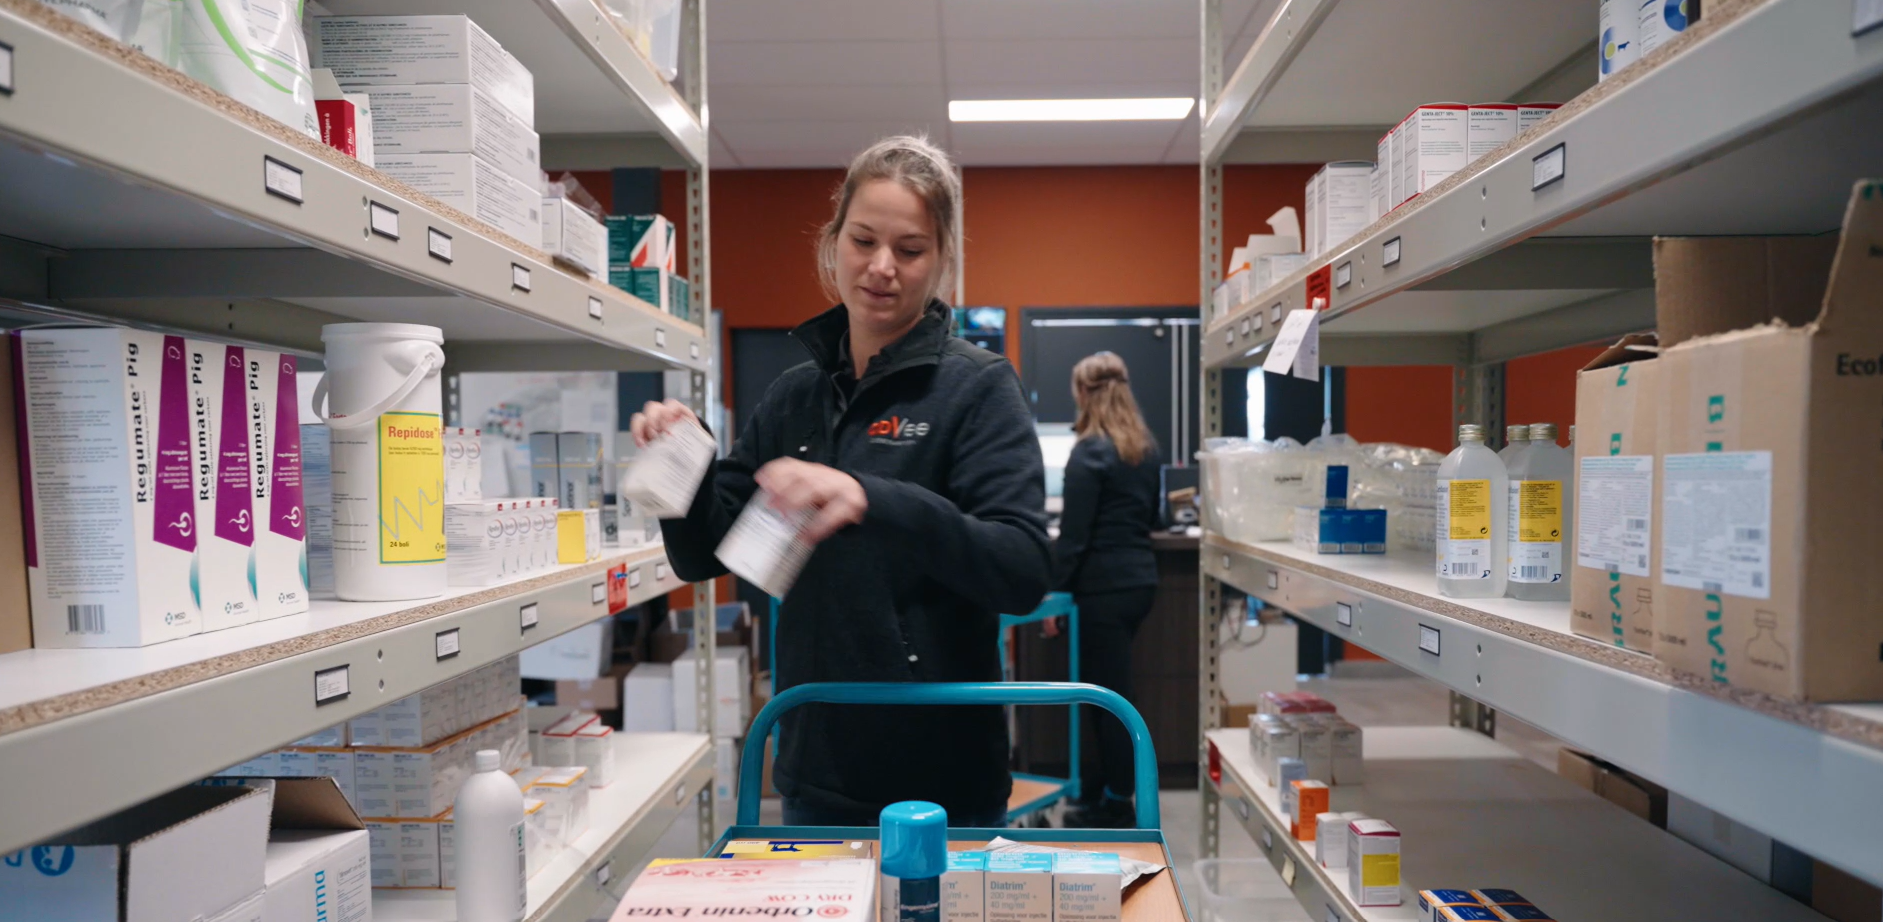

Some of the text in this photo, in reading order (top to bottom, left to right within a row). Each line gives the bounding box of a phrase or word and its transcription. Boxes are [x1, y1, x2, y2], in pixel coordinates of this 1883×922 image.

[126, 342, 139, 377] Pig
[191, 352, 203, 385] Pig
[248, 361, 259, 391] Pig
[764, 893, 852, 902] DRY COW
[1006, 892, 1030, 901] mg/ml
[1060, 893, 1074, 901] 200
[1075, 893, 1099, 903] mg/ml
[1002, 901, 1025, 910] mg/ml
[1071, 903, 1095, 912] mg/ml
[626, 905, 813, 919] Orbenin Extra
